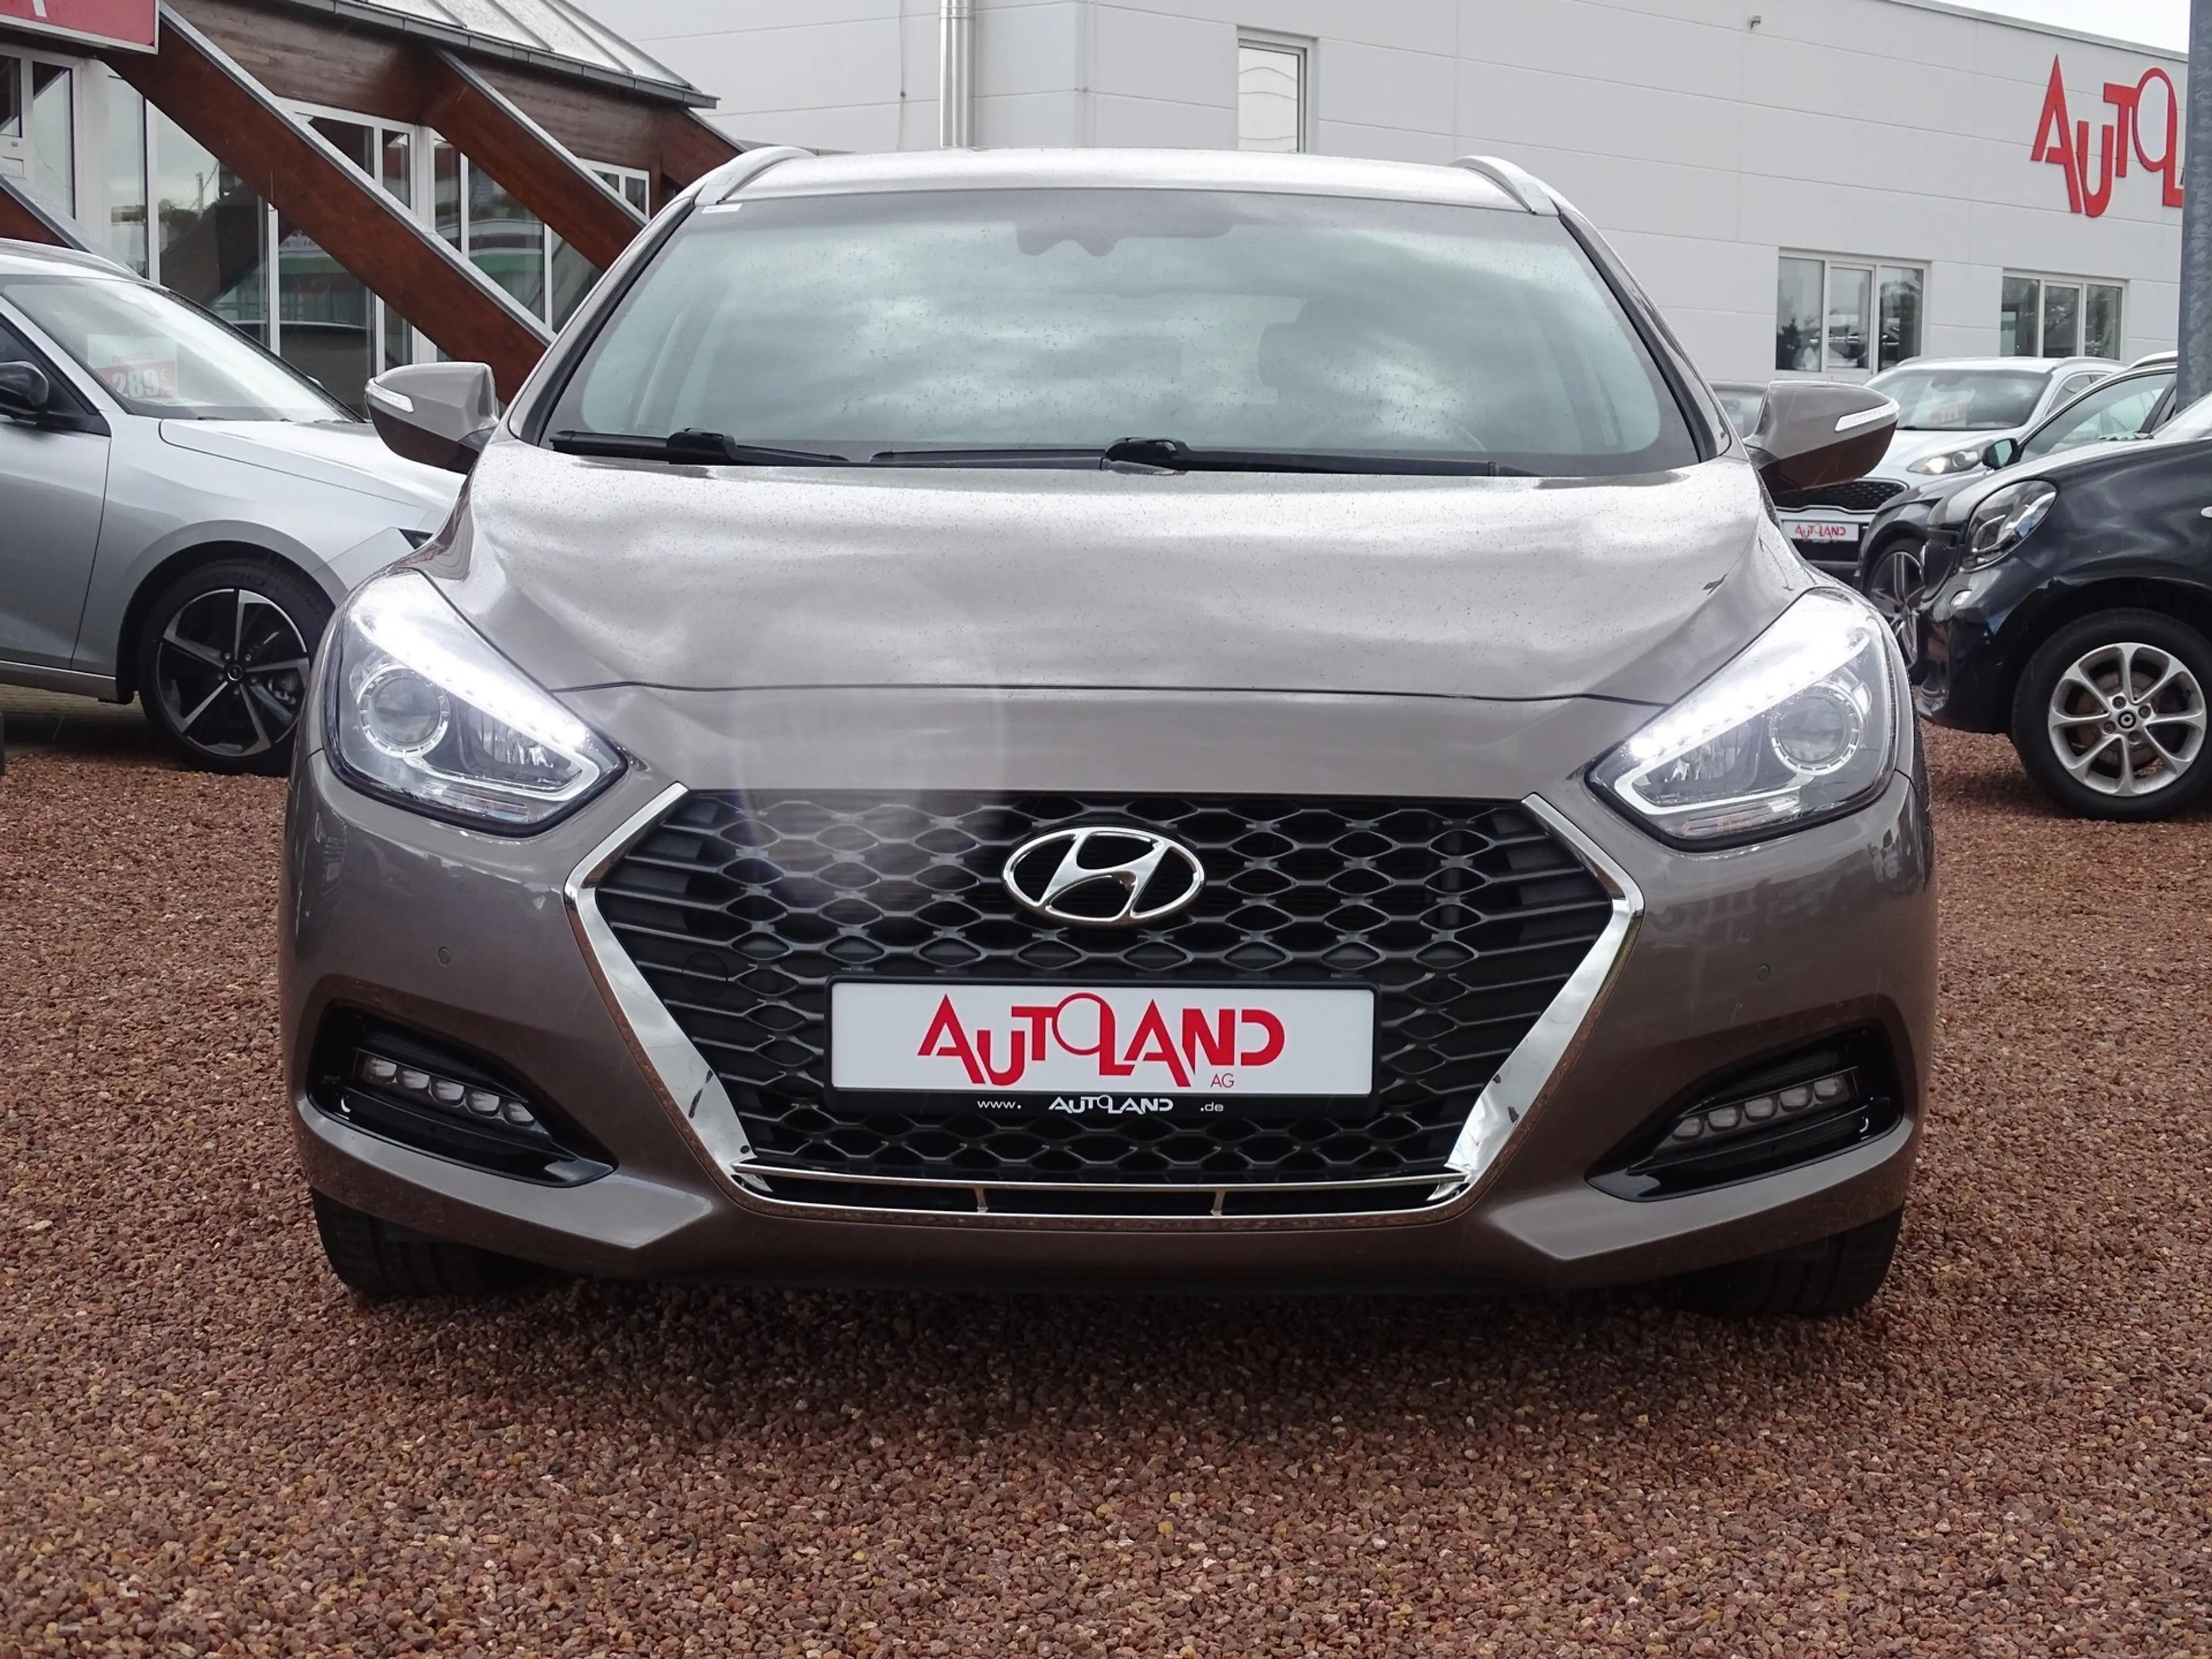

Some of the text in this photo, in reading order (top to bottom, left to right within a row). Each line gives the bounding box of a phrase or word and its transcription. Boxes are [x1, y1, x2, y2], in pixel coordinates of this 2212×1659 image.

[2030, 53, 2184, 218] AUTOL
[918, 993, 1285, 1088] AUTOLAND
[1210, 1073, 1234, 1089] AG
